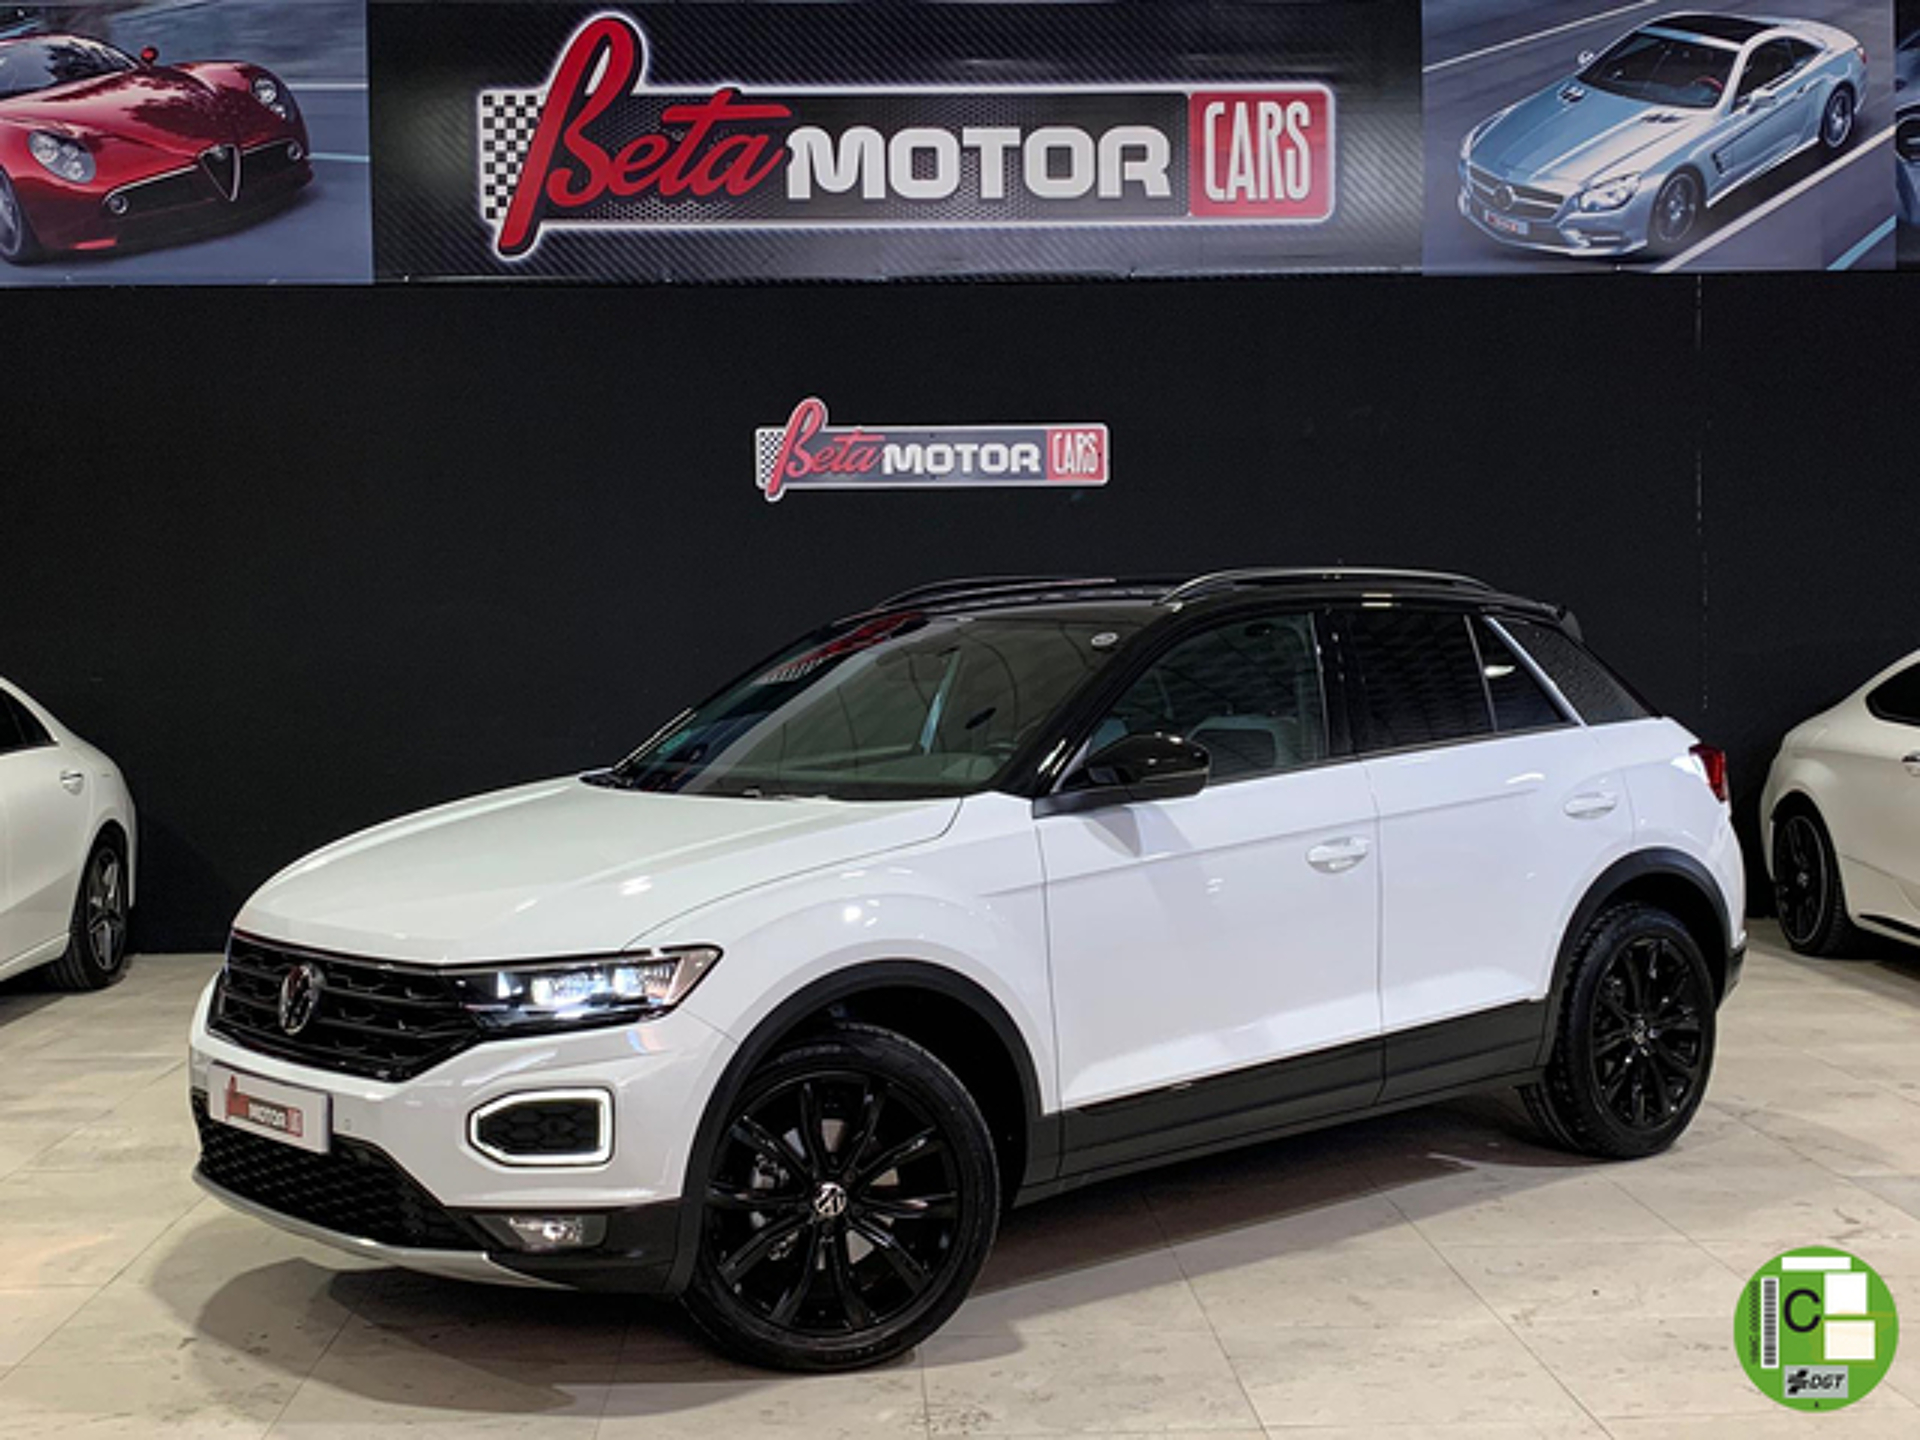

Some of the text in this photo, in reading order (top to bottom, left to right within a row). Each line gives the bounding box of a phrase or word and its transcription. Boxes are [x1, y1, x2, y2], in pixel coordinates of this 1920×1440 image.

[786, 126, 1172, 200] MOTOR
[1204, 100, 1312, 204] CARS
[882, 443, 1041, 474] MOTOR
[1051, 431, 1100, 474] CARS
